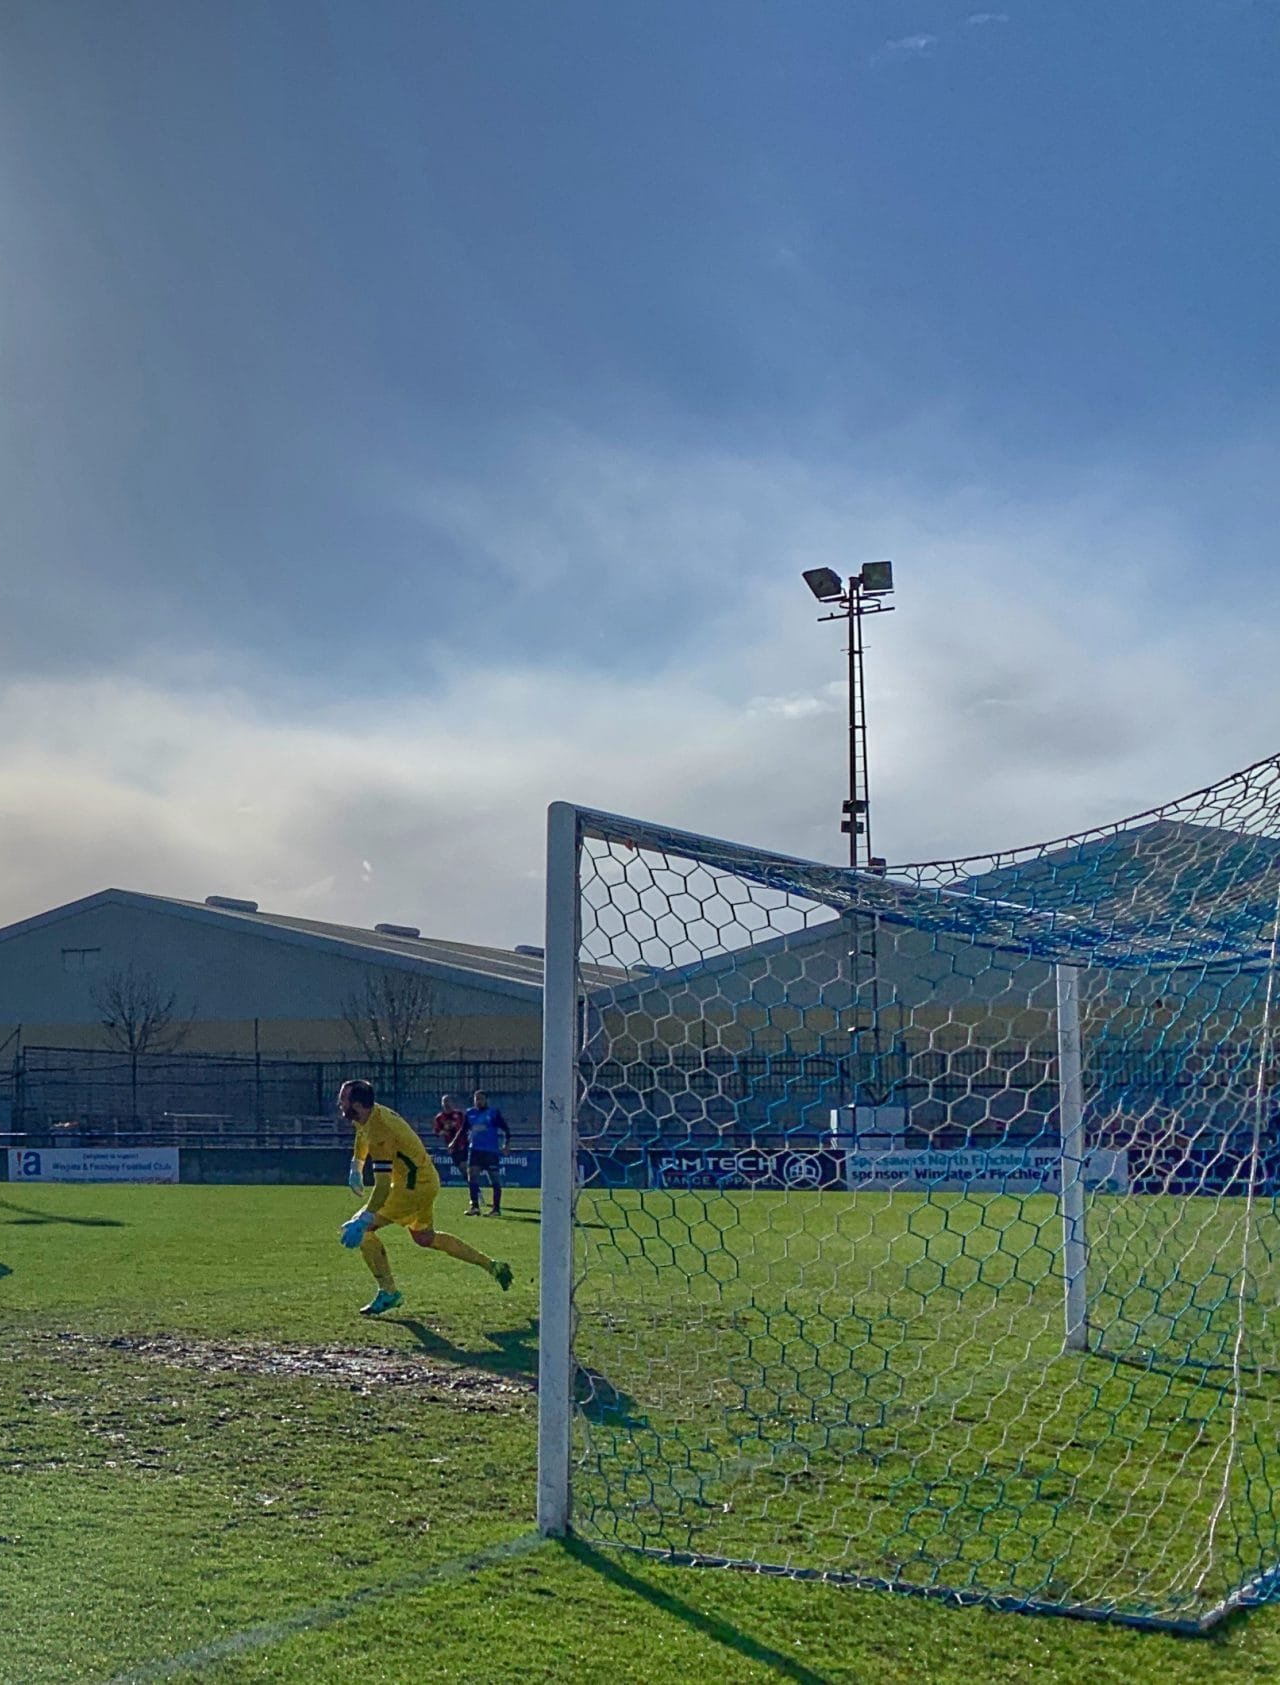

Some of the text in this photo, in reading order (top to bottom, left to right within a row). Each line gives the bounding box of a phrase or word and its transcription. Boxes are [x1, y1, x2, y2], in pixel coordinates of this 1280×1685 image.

[430, 1154, 528, 1167] Finan unting
[928, 1154, 969, 1165] North
[914, 1168, 973, 1182] Wingate
[989, 1168, 1050, 1182] Finchley
